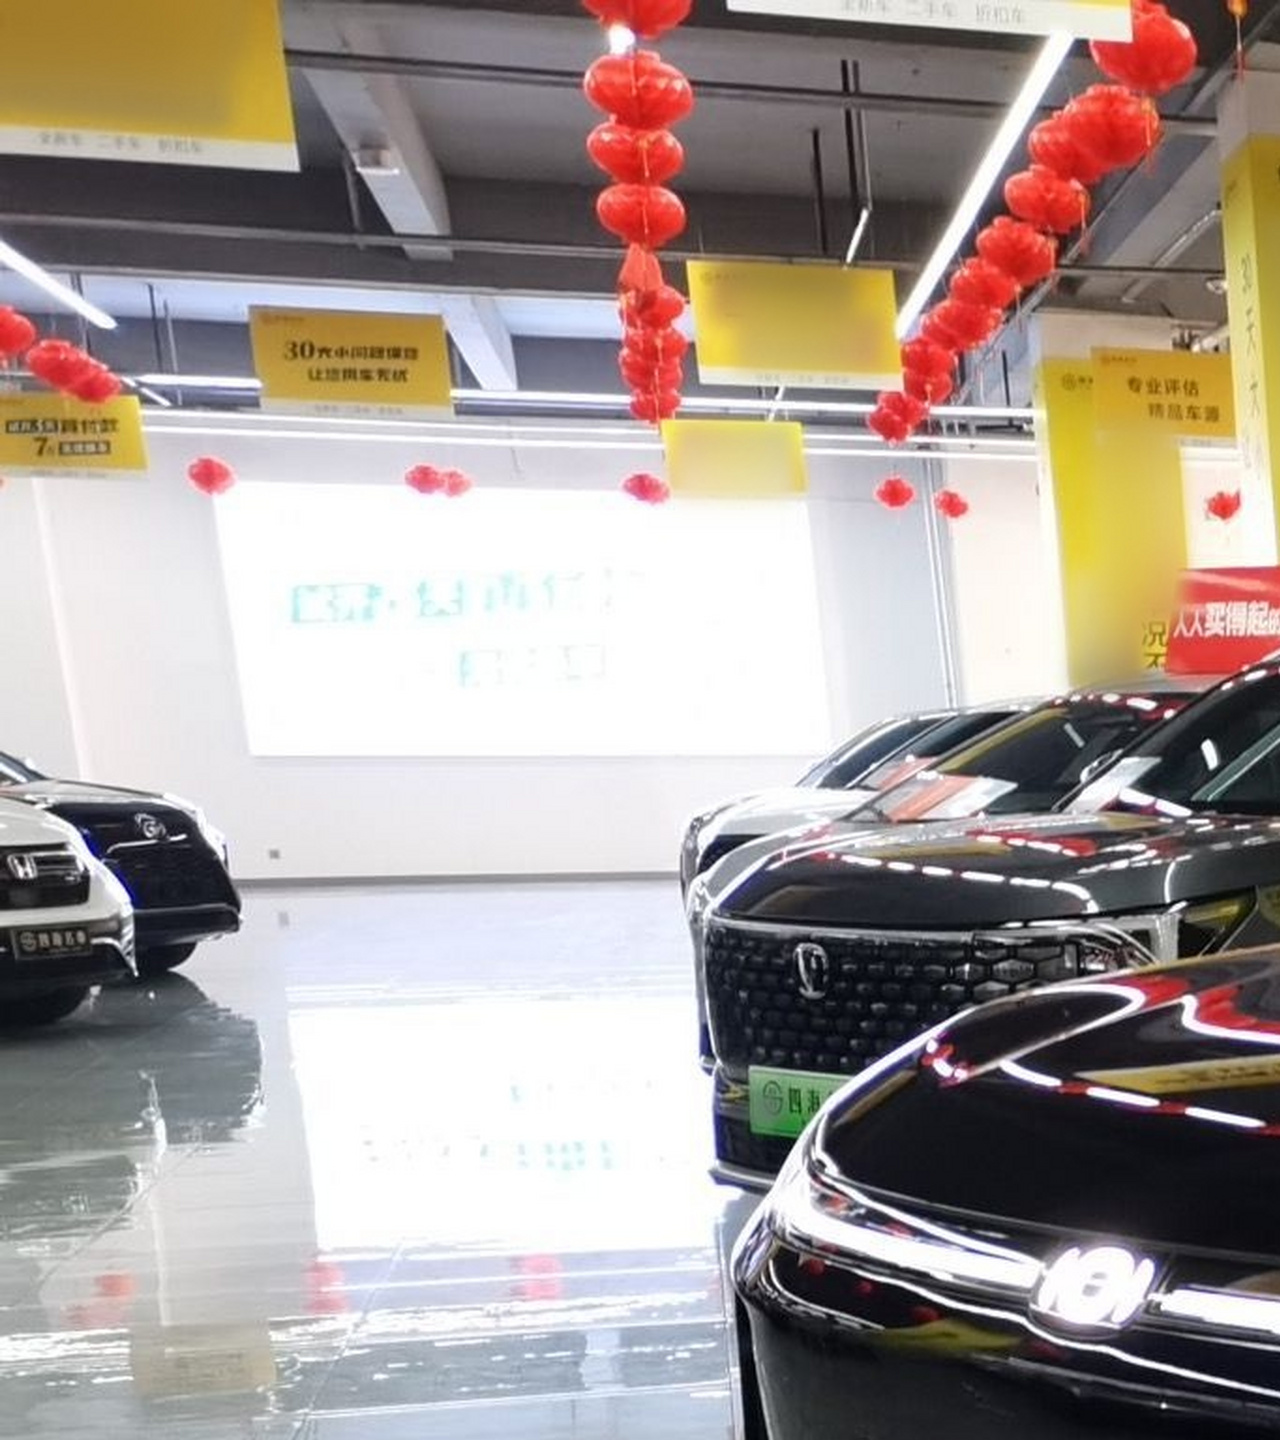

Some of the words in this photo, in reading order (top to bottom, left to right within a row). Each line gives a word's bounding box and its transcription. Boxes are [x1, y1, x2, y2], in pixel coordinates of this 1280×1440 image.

[1127, 375, 1200, 397] 专业评估
[1148, 402, 1220, 423] 精品车源
